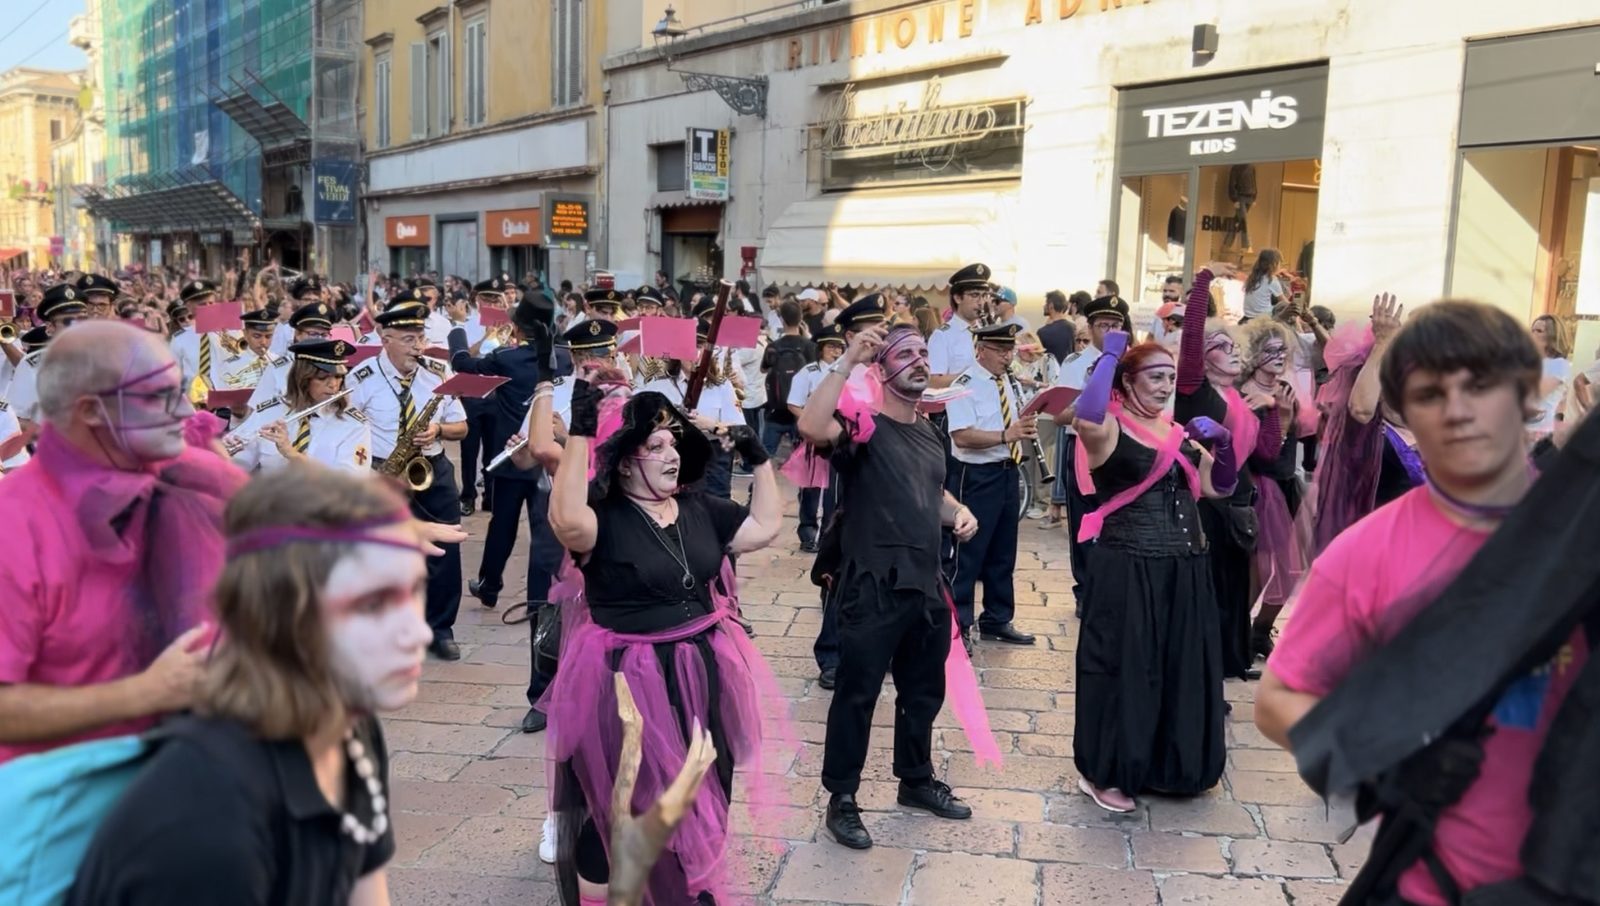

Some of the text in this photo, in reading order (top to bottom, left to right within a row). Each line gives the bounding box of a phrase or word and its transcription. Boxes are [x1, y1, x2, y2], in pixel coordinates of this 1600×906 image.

[1189, 137, 1237, 156] KIDS
[318, 176, 337, 185] FES
[325, 185, 350, 194] TIVAL
[318, 192, 350, 201] VERDI
